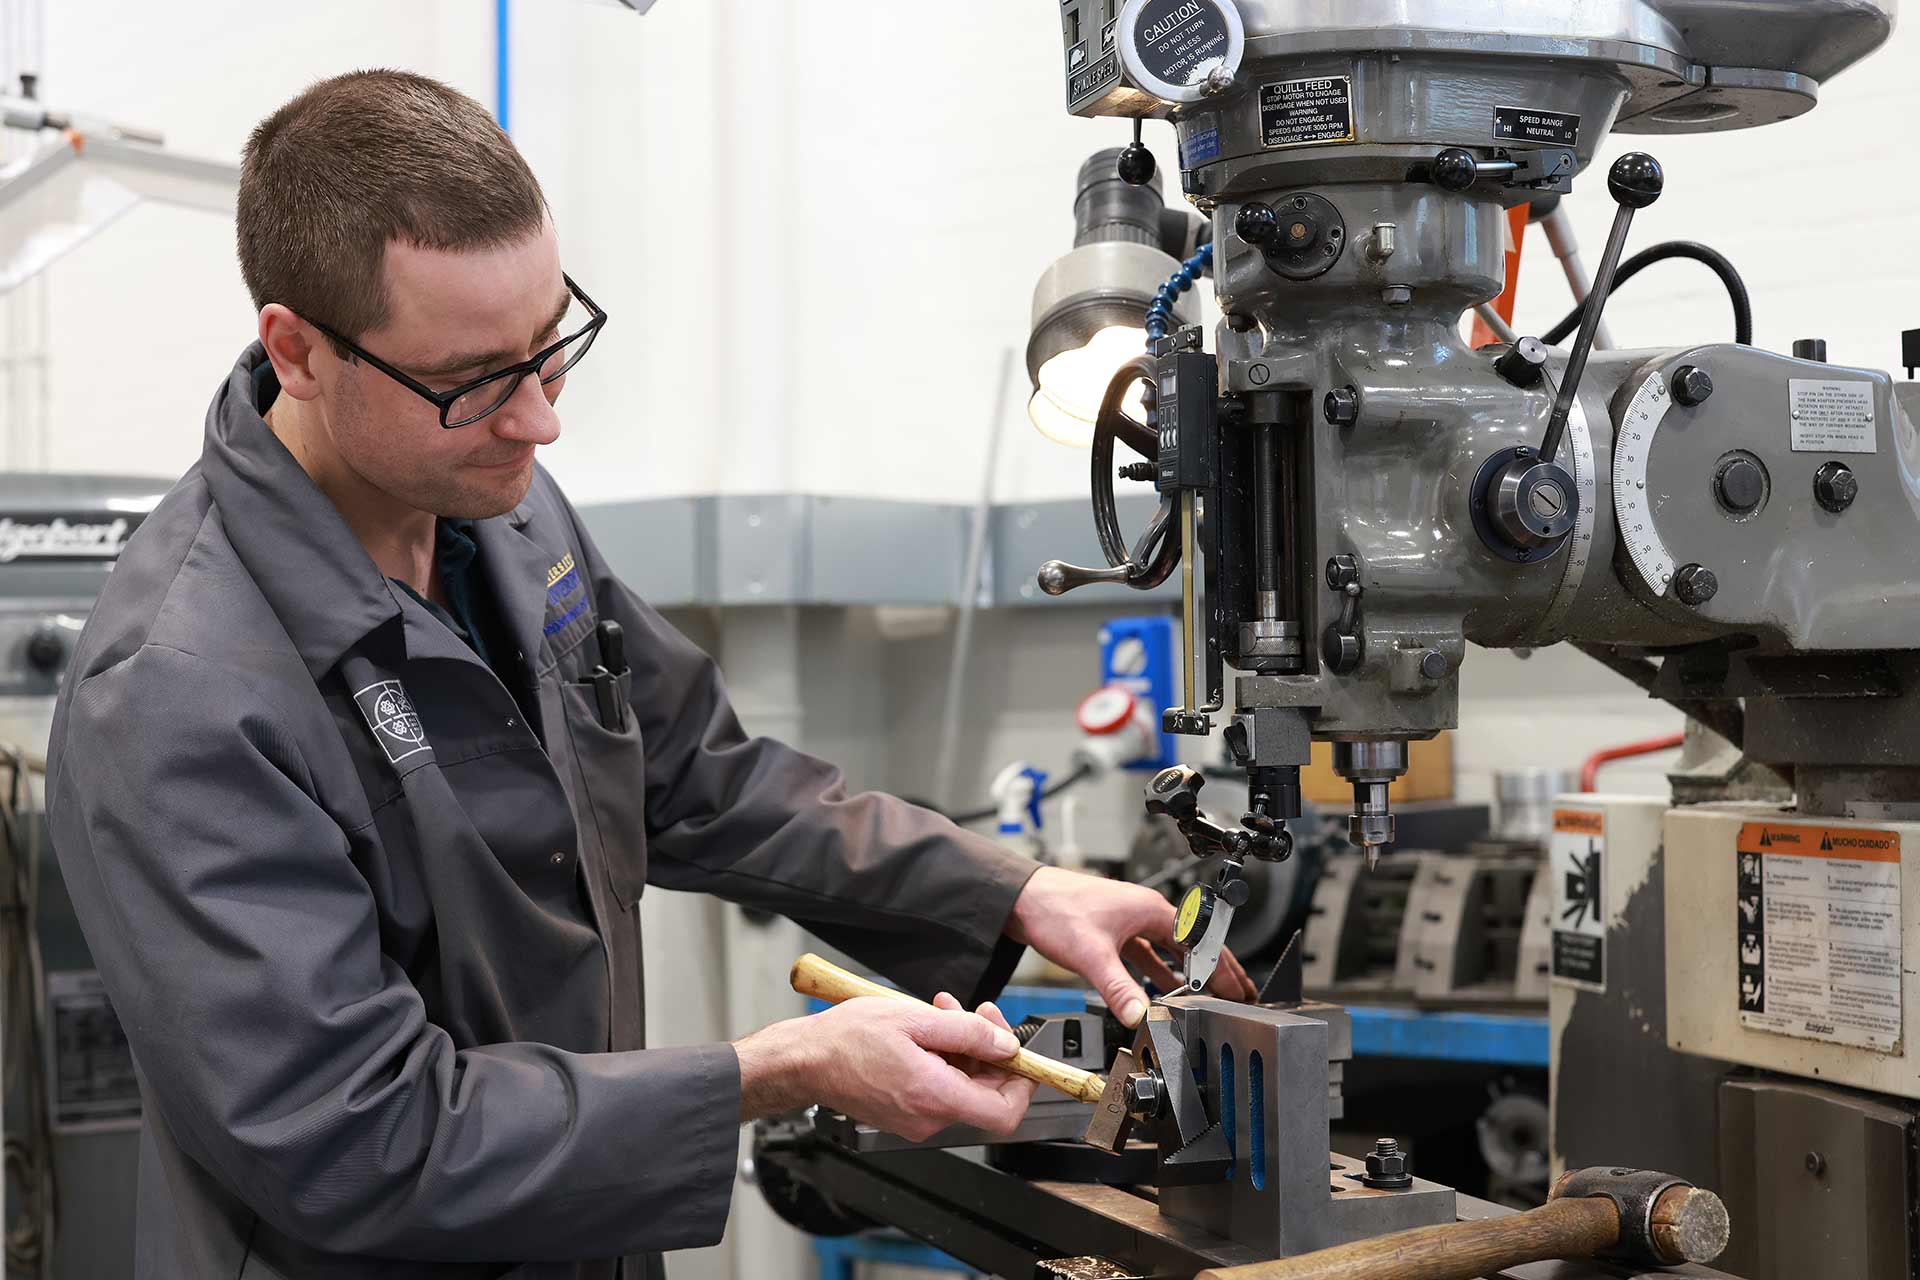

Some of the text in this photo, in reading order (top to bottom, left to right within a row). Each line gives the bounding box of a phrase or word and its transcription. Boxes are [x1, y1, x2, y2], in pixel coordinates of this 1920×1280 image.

[1143, 0, 1200, 41] CAUTION
[1158, 19, 1205, 53] DO NOT TURN
[1174, 35, 1202, 56] UNLESS
[1162, 33, 1225, 77] MOTOR IS RUNNING
[1073, 60, 1115, 95] SPINDLE SPEED
[1273, 80, 1332, 95] QUILL FEED
[1266, 95, 1282, 103] STOP
[1282, 92, 1305, 101] MOTOR
[1315, 88, 1342, 96] ENGAGE
[1262, 102, 1295, 112] DISENGAGE
[1295, 99, 1315, 108] WHEN
[1315, 98, 1329, 106] NOT
[1289, 107, 1318, 117] WARNING
[1285, 118, 1298, 126] NOT
[1298, 115, 1325, 124] ENGAGE
[1519, 115, 1563, 127] SPEED RANGE
[1268, 122, 1344, 136] SPEEDS ABOVE 3000 RPM
[1503, 125, 1572, 139] HI NEUTRAL LO
[1268, 130, 1345, 145] DISENGAGE ENGAGE
[1650, 394, 1660, 403] 40
[1640, 411, 1649, 421] 30
[1577, 425, 1583, 433] 0
[1632, 432, 1641, 441] 20
[1627, 455, 1635, 463] 10
[1584, 478, 1594, 486] 20
[1584, 506, 1593, 514] 30
[1628, 502, 1636, 510] 10
[1633, 523, 1643, 532] 20
[1582, 533, 1591, 541] 40
[1643, 544, 1652, 554] 30
[1576, 559, 1586, 567] 50
[1655, 562, 1664, 572] 40
[1833, 837, 1890, 850] MUCHO CUIDADO
